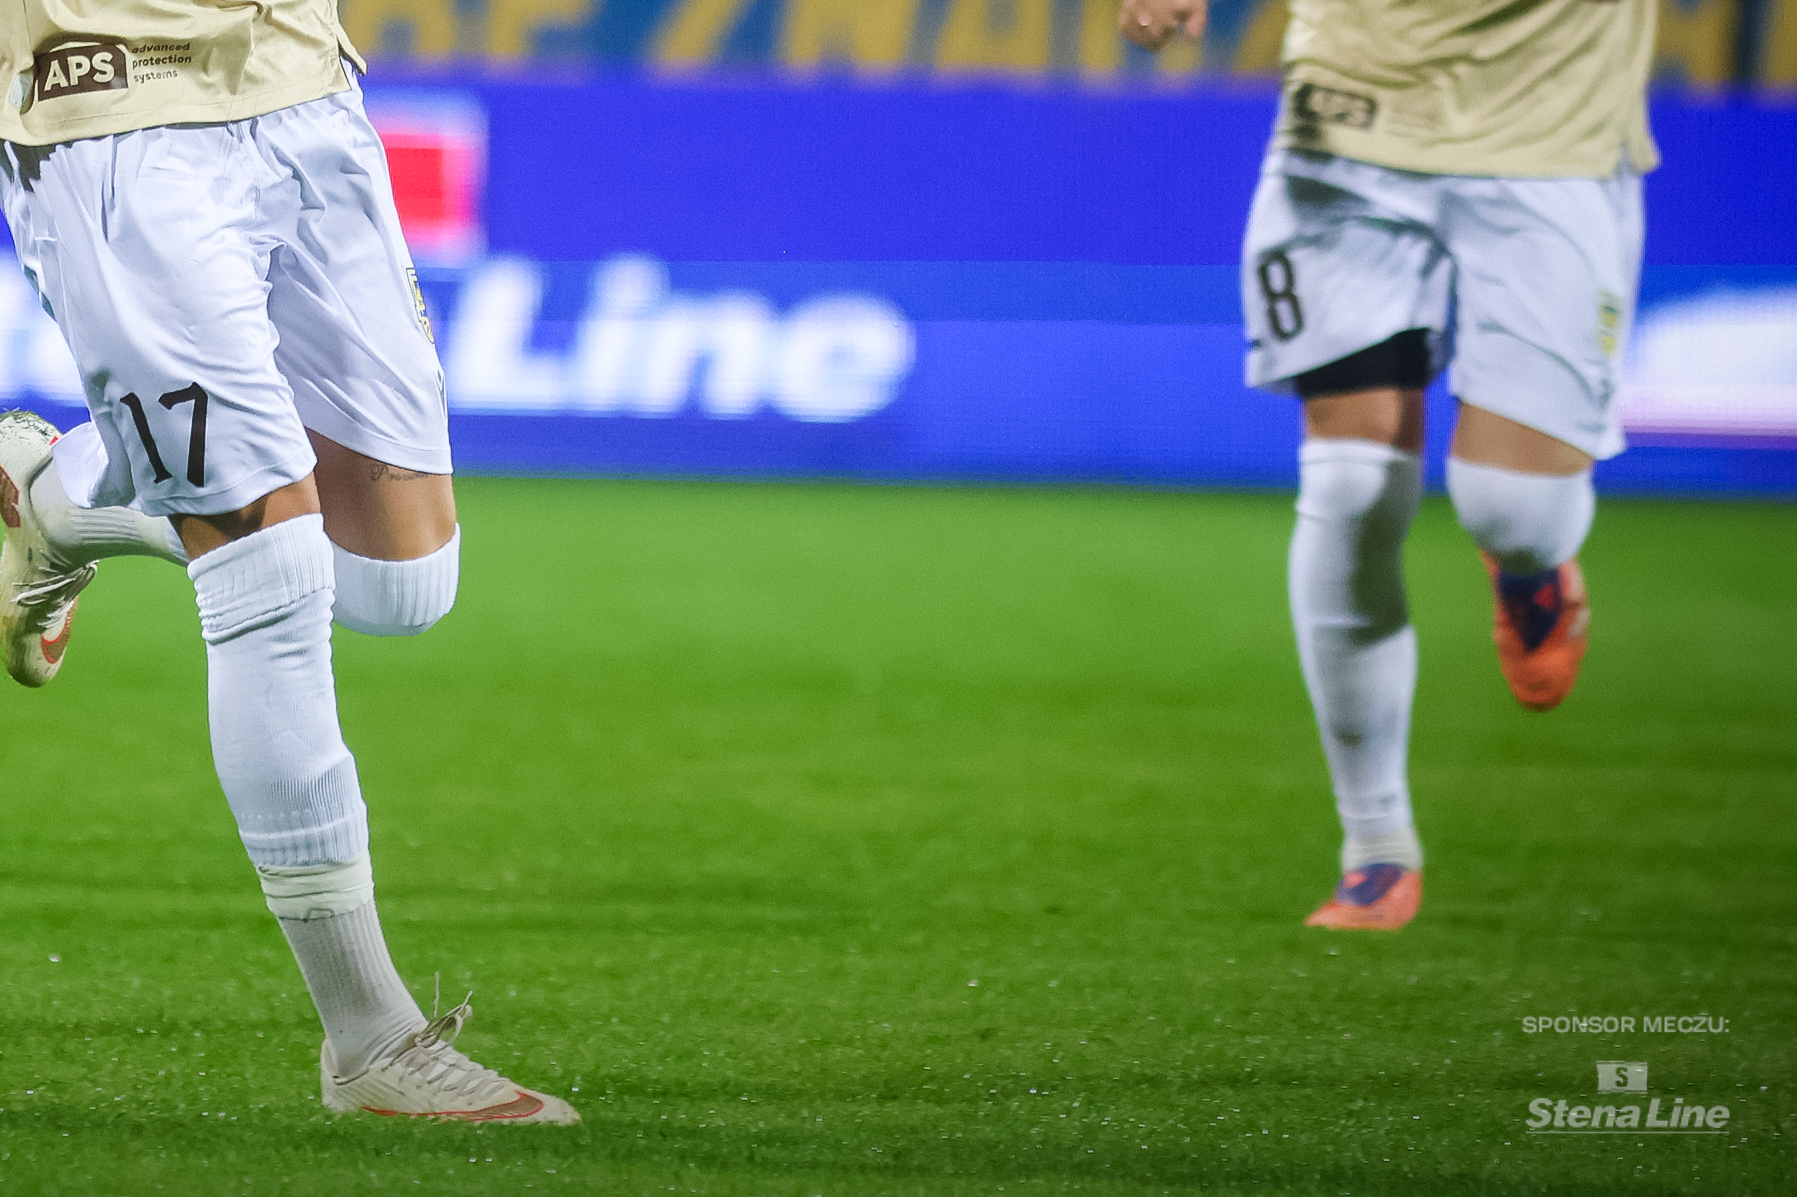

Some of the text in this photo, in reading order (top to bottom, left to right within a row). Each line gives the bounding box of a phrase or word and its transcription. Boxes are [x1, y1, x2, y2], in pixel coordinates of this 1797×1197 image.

[131, 42, 191, 54] advanced
[131, 53, 192, 70] protection
[43, 51, 115, 92] APS
[133, 69, 179, 84] systems
[119, 381, 209, 488] 17
